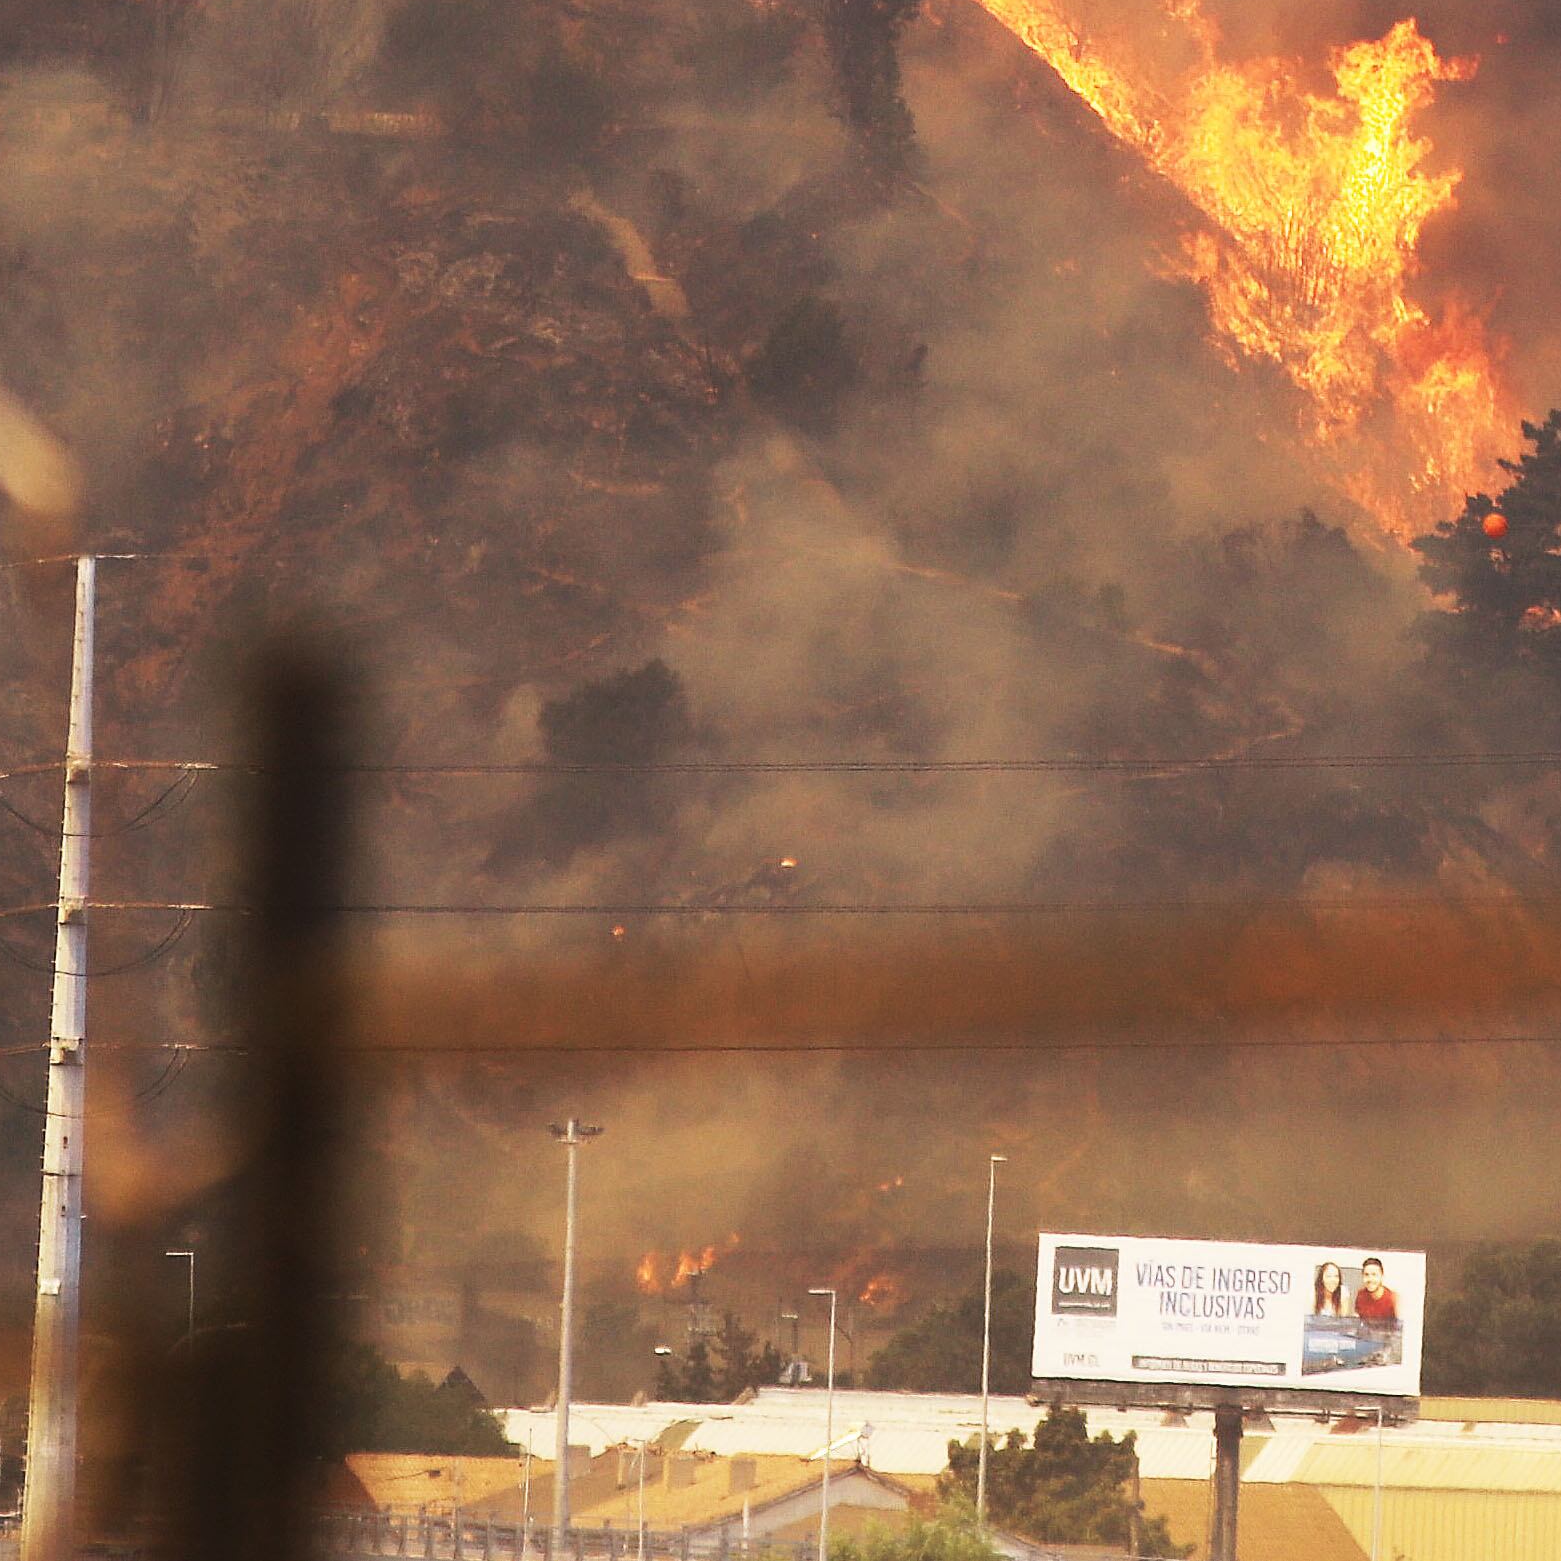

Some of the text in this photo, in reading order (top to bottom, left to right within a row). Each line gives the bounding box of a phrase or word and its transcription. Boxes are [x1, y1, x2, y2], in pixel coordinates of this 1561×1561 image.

[1059, 1267, 1113, 1296] UVM
[1136, 1260, 1291, 1294] VÍAS DE INGRESO
[1159, 1291, 1266, 1319] INCLUSIVAS
